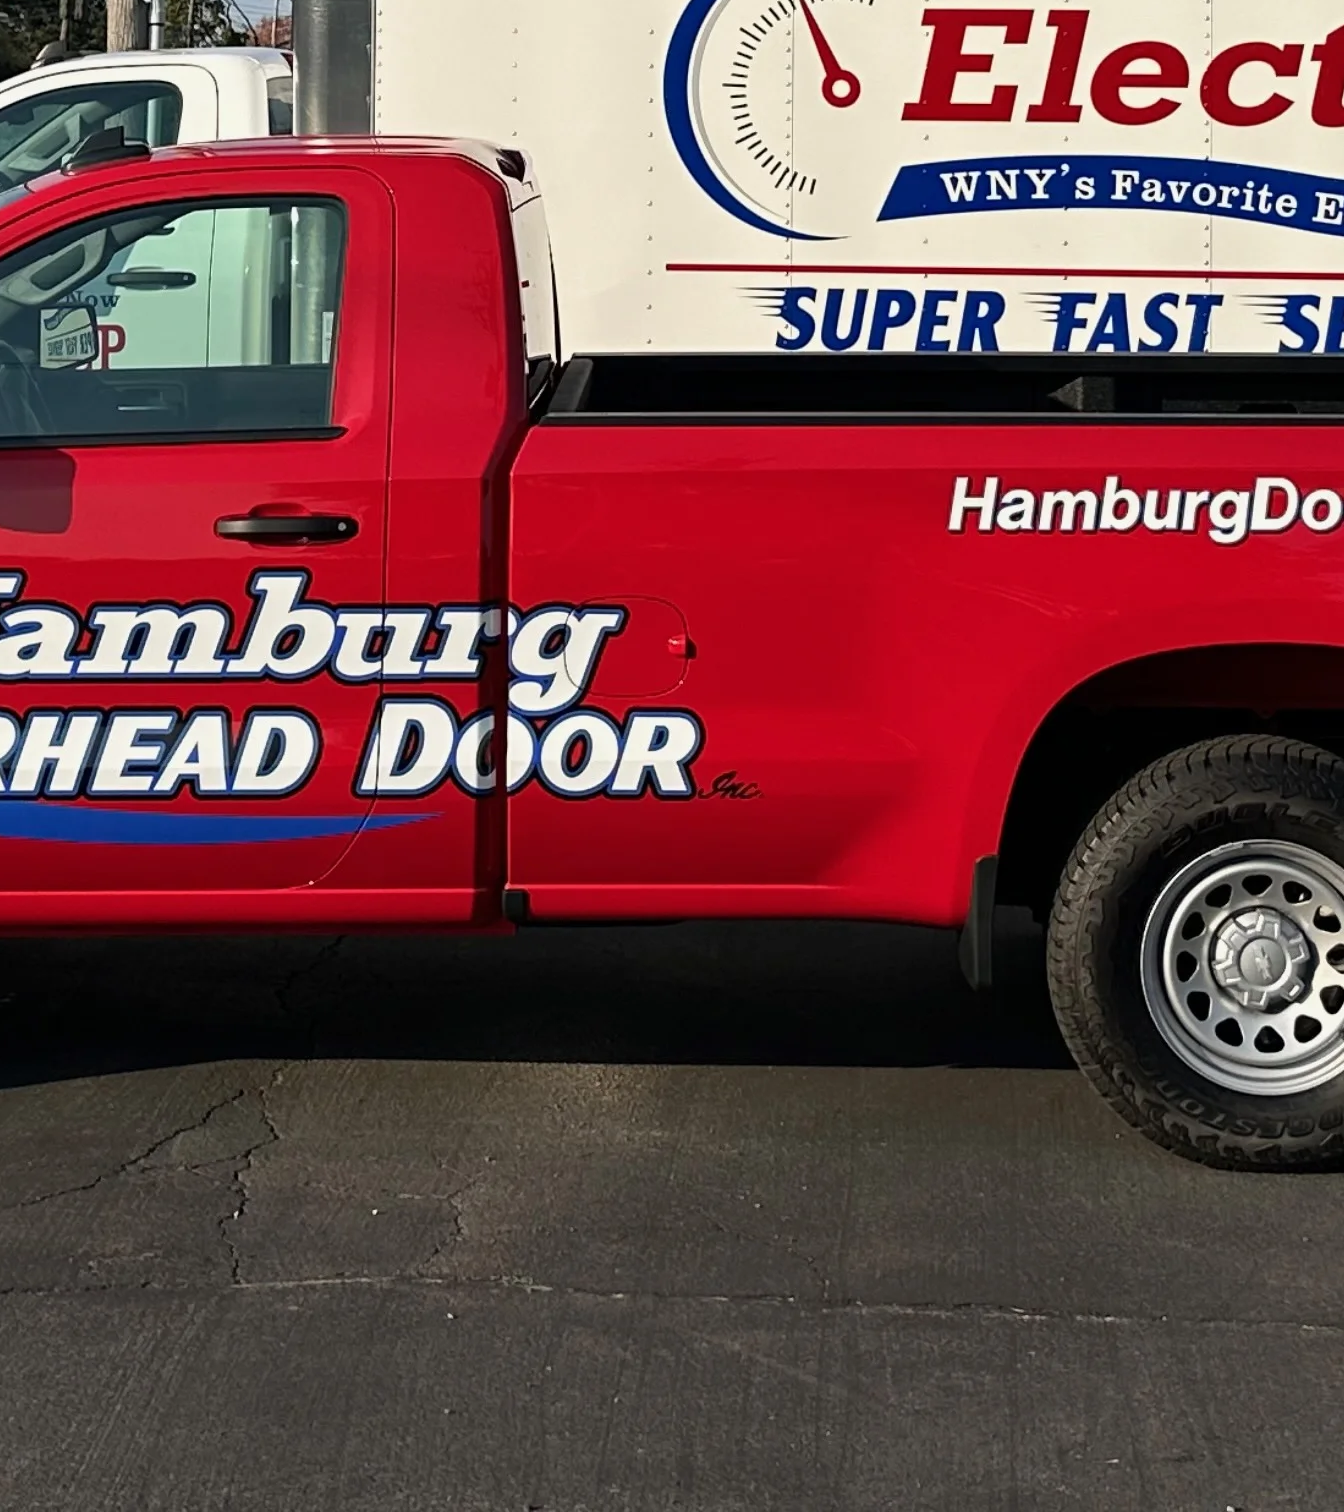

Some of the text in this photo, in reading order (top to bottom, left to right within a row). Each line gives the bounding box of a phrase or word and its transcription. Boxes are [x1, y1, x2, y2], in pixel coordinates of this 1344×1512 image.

[940, 163, 1097, 204] WNY's
[1110, 169, 1299, 218] Favorite
[65, 290, 121, 307] Now
[768, 286, 1006, 353] SUPER
[1042, 292, 1224, 353] FAST
[359, 697, 705, 798] DOOR
